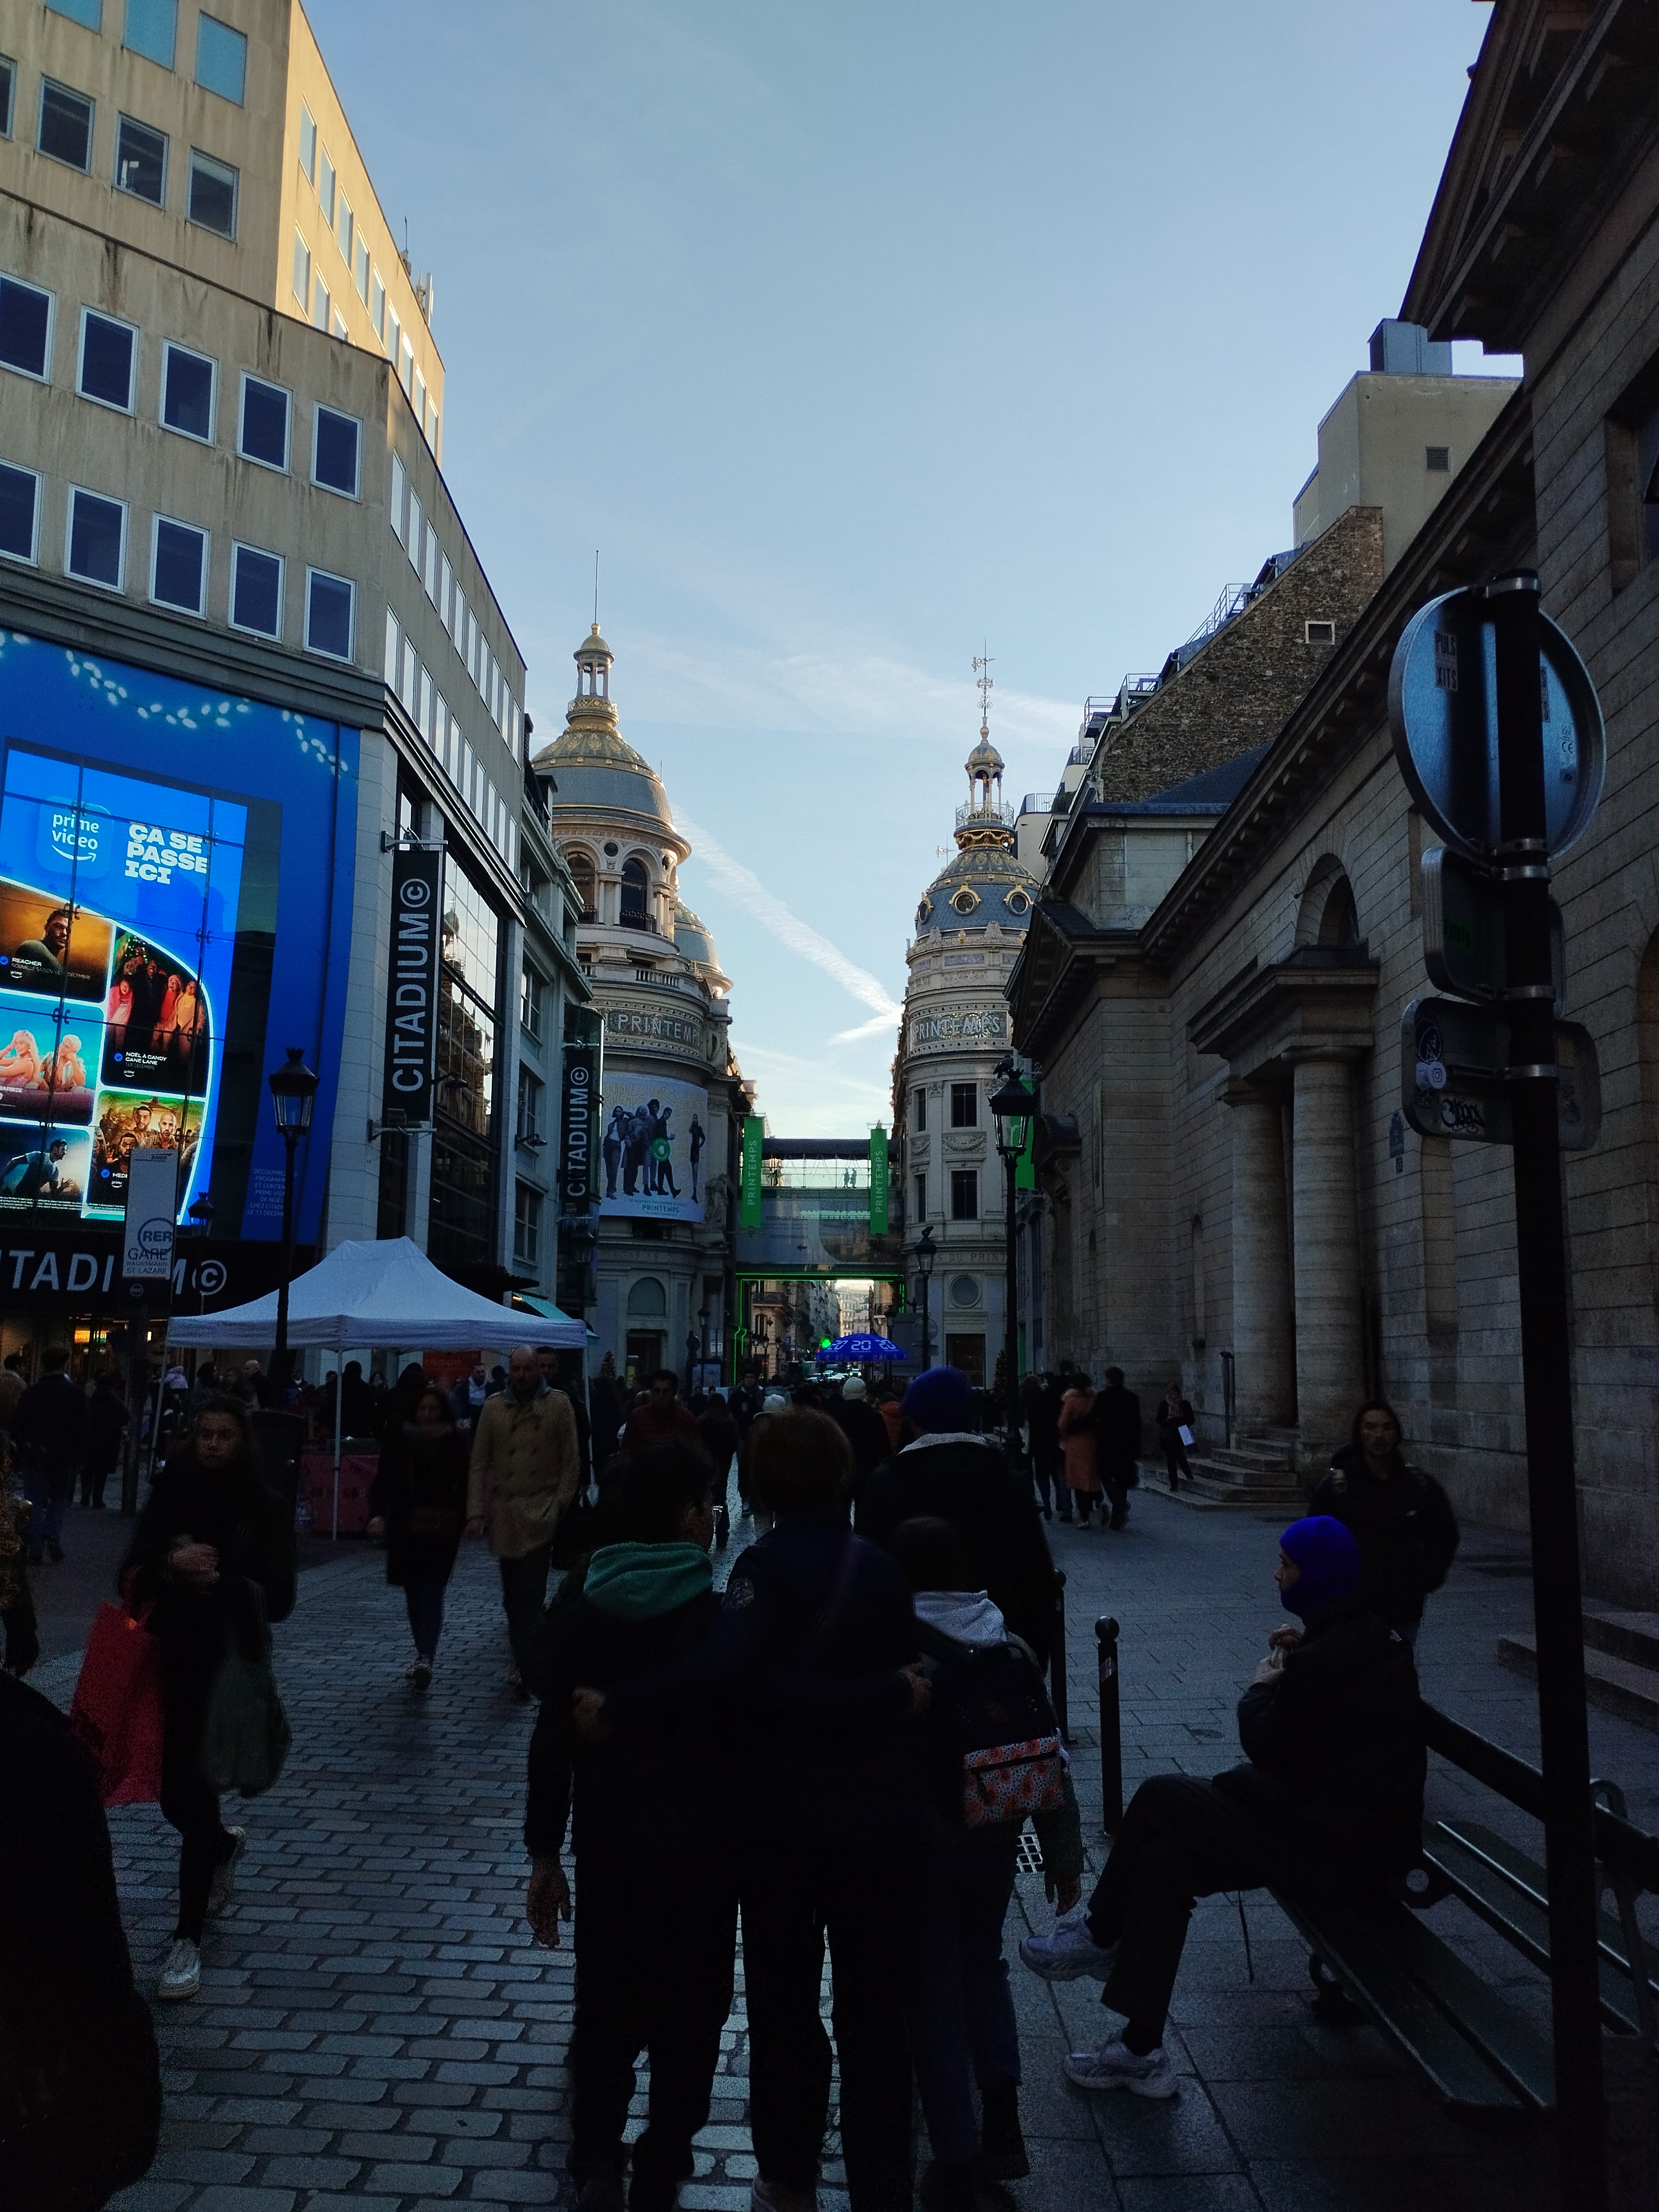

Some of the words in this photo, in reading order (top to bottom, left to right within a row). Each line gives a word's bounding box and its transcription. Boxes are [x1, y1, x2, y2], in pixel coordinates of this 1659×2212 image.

[53, 813, 100, 833] prime
[52, 828, 98, 850] video
[129, 824, 165, 846] ÇA
[169, 832, 204, 854] SE
[127, 841, 208, 874] PASSE
[125, 860, 171, 884] ICI
[12, 957, 42, 966] REACHER
[915, 1016, 1000, 1041] PRINTEMPS
[748, 1140, 757, 1205] PRINTEMPS
[642, 1204, 680, 1213] PRINTEMPS
[143, 1230, 172, 1242] RER
[128, 1247, 168, 1261] GARE
[851, 1340, 872, 1350] 20
